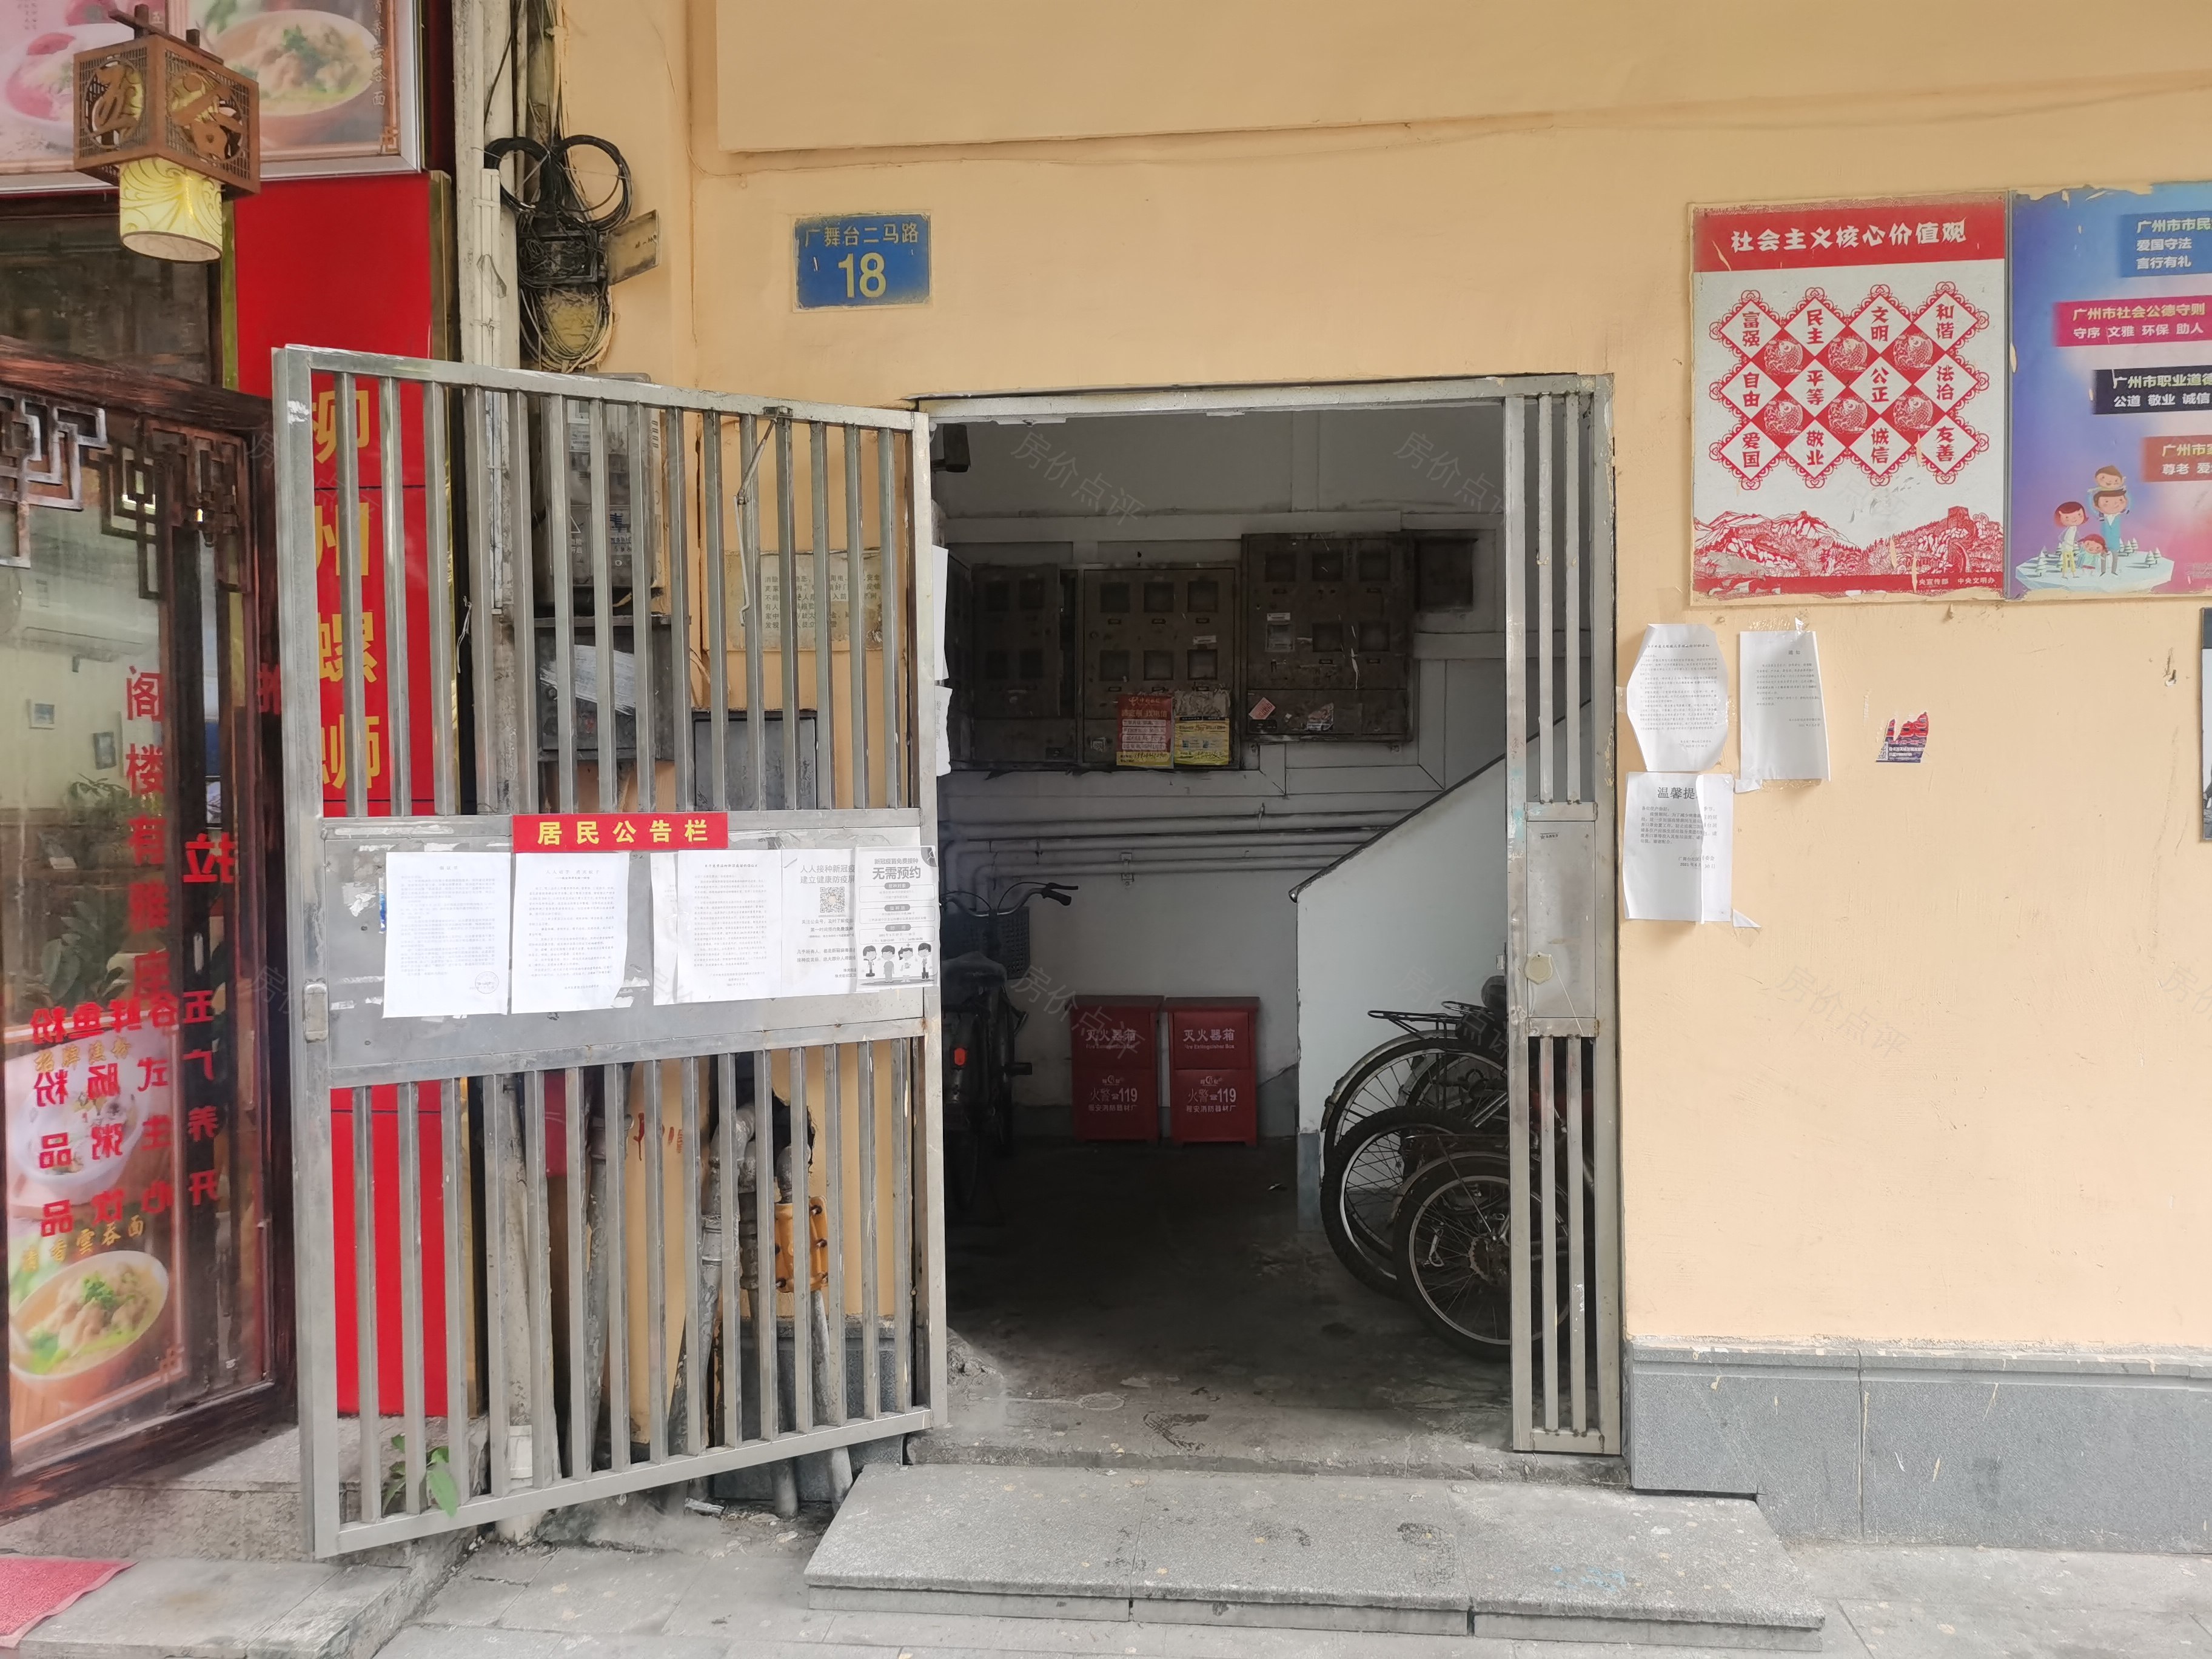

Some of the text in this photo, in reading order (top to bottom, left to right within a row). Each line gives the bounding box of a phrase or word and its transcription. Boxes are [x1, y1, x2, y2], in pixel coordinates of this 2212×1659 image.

[805, 223, 919, 247] 广舞台二马路
[1730, 219, 1968, 253] 社会主义核心价值观
[2137, 217, 2212, 233] 广州市市民
[2136, 238, 2192, 252] 爱国守法
[2136, 255, 2191, 270] 言行有礼
[838, 252, 886, 298] 18
[1936, 303, 1954, 341] 和谐
[2073, 303, 2205, 321] 广州市社会公德守则
[1741, 311, 1760, 348] 富强
[1806, 309, 1824, 345] 民主
[1871, 306, 1889, 343] 文明
[2073, 323, 2204, 340] 守序 文雅 环保 助人
[1743, 372, 1760, 408] 自由
[1806, 369, 1825, 407] 平等
[1871, 366, 1889, 403] 公正
[1936, 364, 1954, 401] 法治
[2114, 373, 2212, 389] 广州市职业道德
[2113, 392, 2211, 407] 公道 敬业 诚信
[1741, 432, 1760, 469] 爱国
[1806, 430, 1824, 466] 敬业
[1870, 427, 1889, 465] 诚信
[1936, 425, 1956, 462] 友善
[2162, 462, 2212, 475] 尊老 爱
[1918, 577, 1949, 586] 央宣传部
[1657, 786, 1698, 799] 温馨提
[537, 819, 708, 845] 居民公告栏
[873, 866, 921, 880] 无需预约
[1085, 1028, 1136, 1042] 灭火器箱
[1183, 1029, 1235, 1042] 灭火器箱
[1090, 1087, 1138, 1102] 火警 119
[1188, 1088, 1236, 1102] 火警 119
